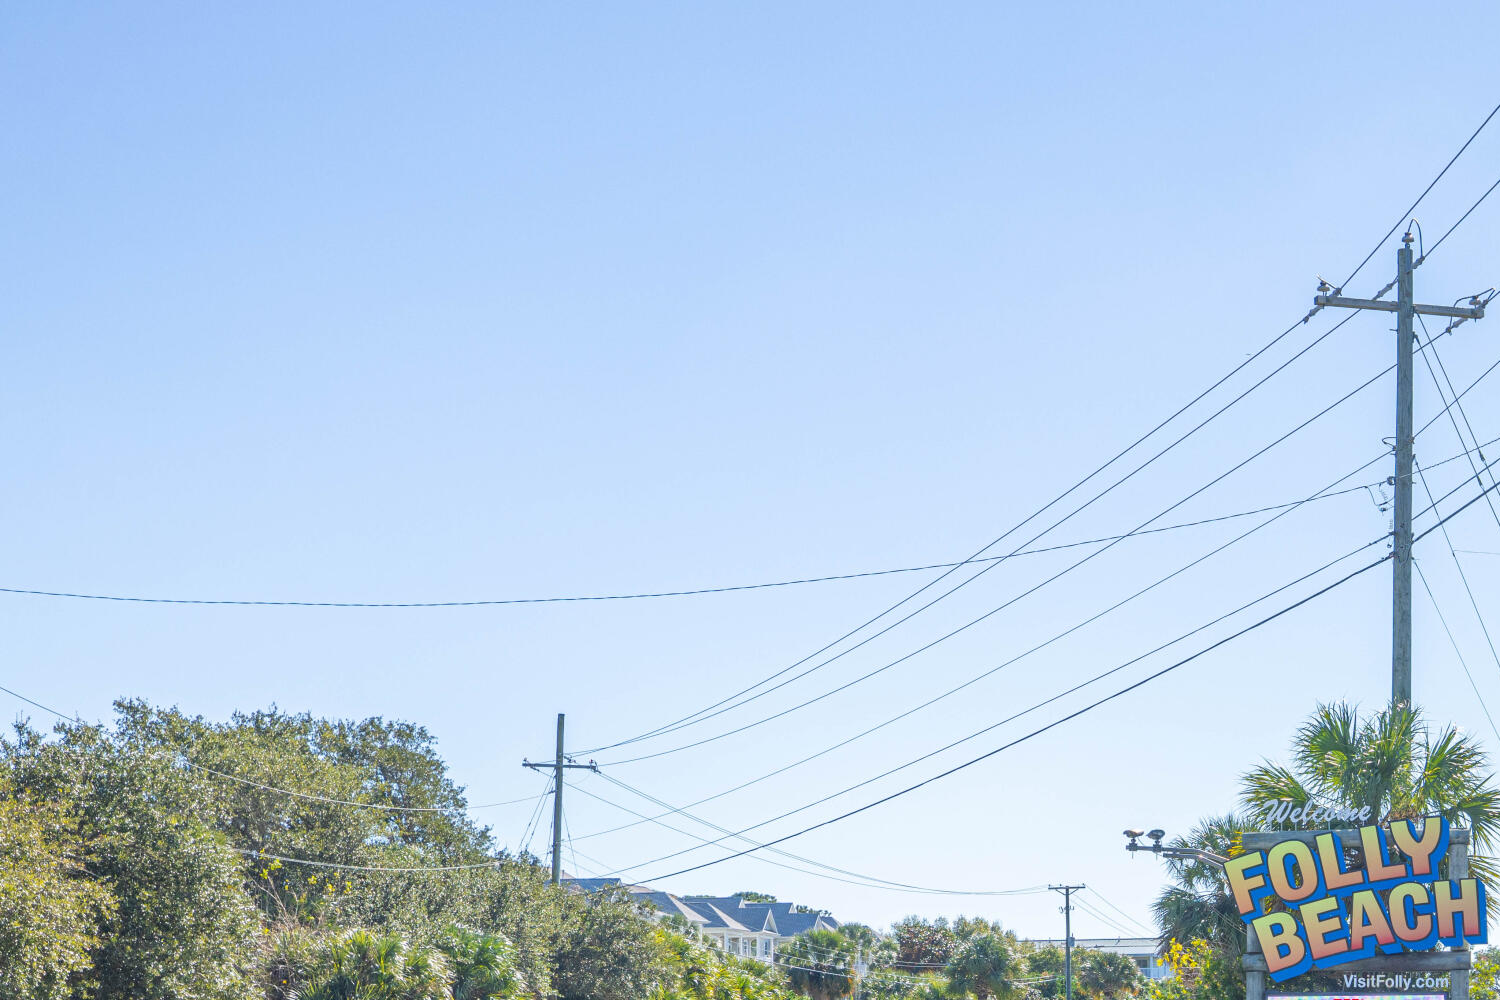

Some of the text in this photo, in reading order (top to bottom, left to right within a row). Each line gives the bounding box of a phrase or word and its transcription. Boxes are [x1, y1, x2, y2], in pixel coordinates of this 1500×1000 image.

[1262, 799, 1372, 823] Welcome
[1223, 816, 1445, 918] FOLLY
[1252, 877, 1483, 977] BEACH
[1344, 974, 1450, 990] VisitFolly.com
